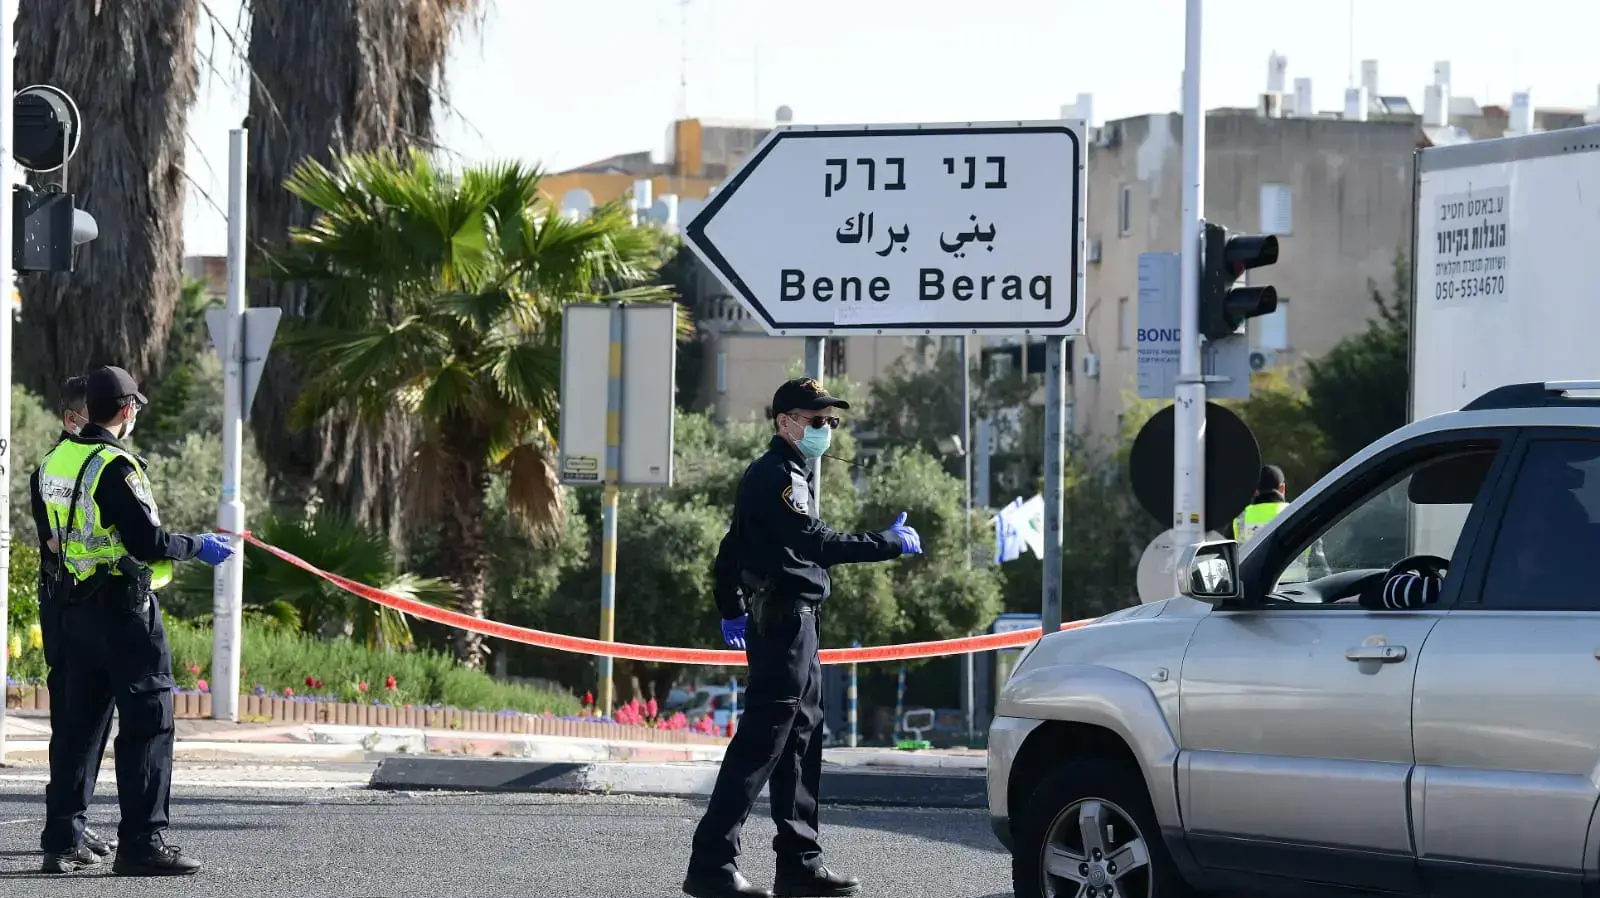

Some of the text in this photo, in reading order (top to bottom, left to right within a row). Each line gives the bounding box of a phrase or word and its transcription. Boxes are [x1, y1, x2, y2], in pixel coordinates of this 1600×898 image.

[824, 156, 1007, 198] בני ברק
[835, 211, 997, 258] بني براك
[780, 267, 1053, 310] Bene Beraq
[1435, 275, 1505, 301] 050-5534670
